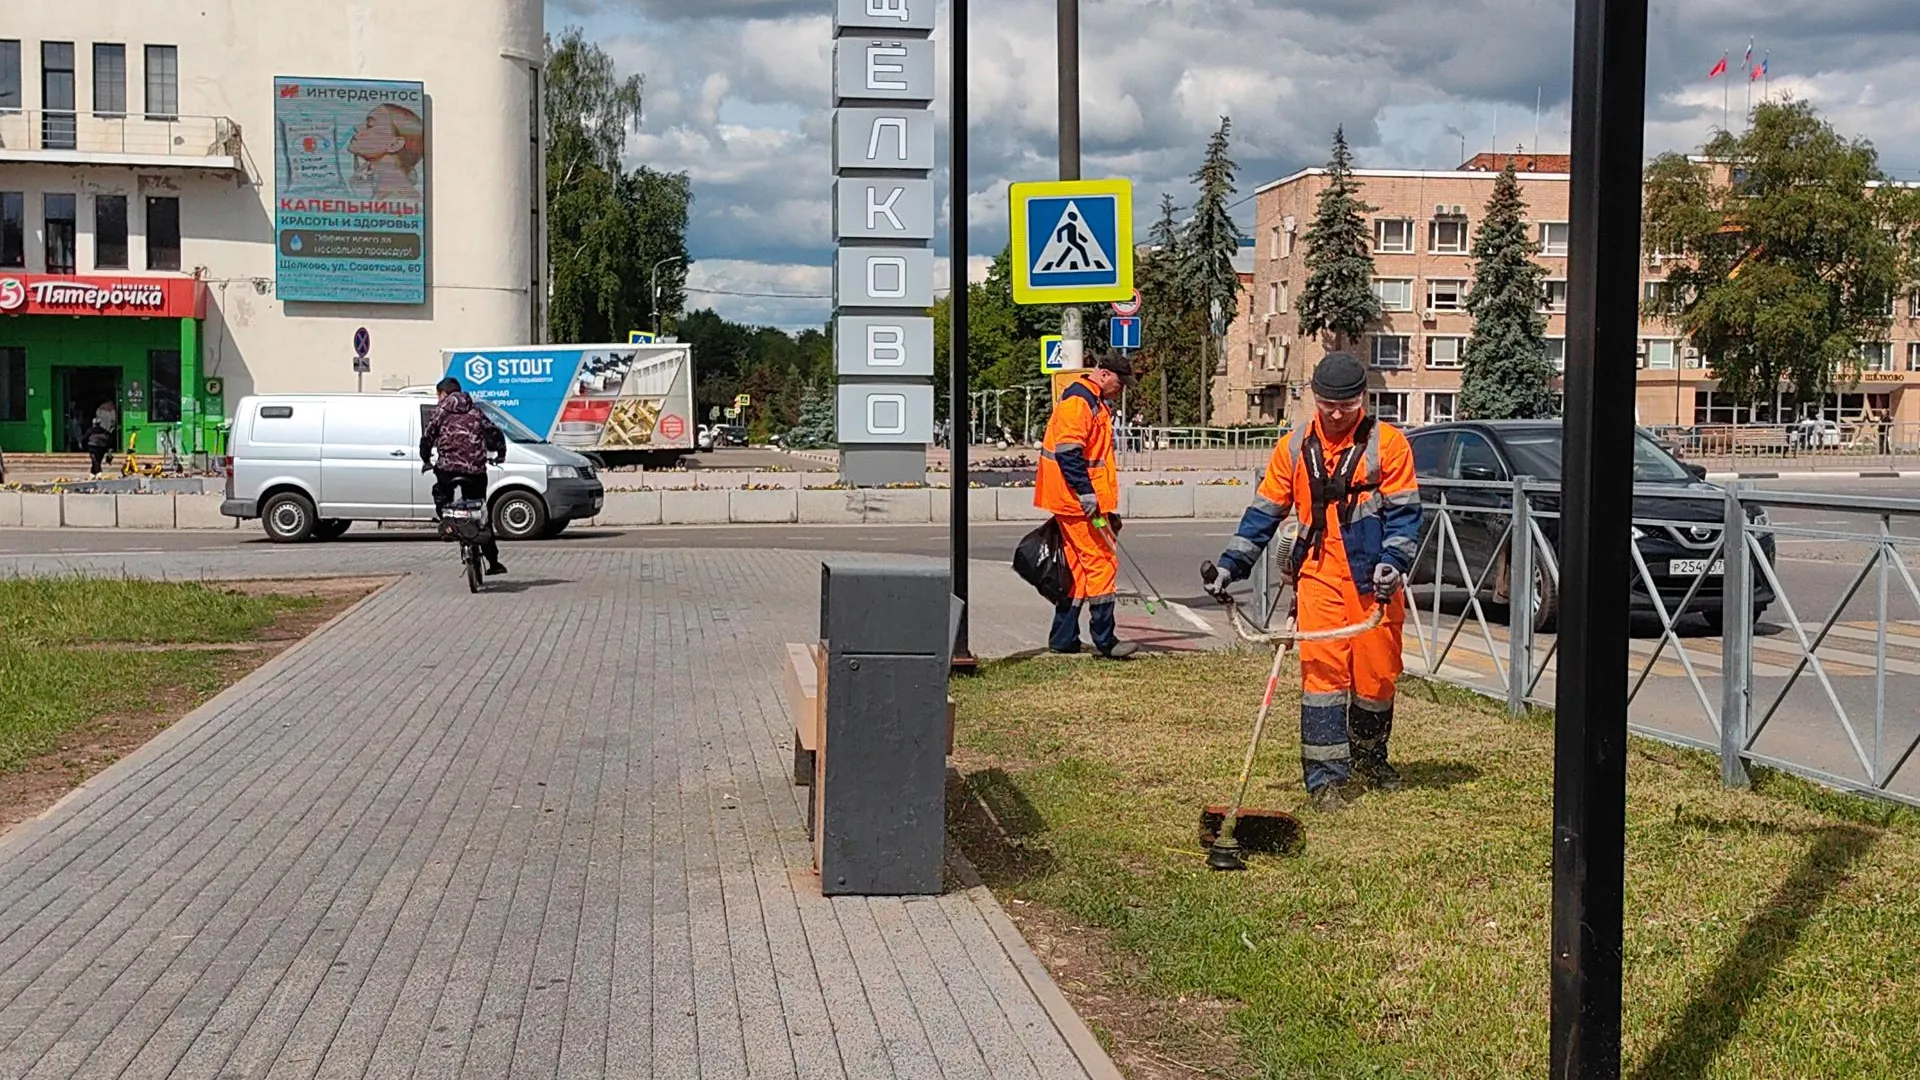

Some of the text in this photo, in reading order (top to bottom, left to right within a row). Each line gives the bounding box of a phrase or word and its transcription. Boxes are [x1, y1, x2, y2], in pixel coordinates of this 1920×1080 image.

[306, 87, 419, 102] интердентос
[280, 198, 420, 217] КАПЕЛЬНИЦЫ
[280, 215, 419, 230] КРАСОТЫ И ЗДОРОВЬЯ
[30, 281, 163, 309] Пятерочка
[497, 358, 554, 376] STOUT
